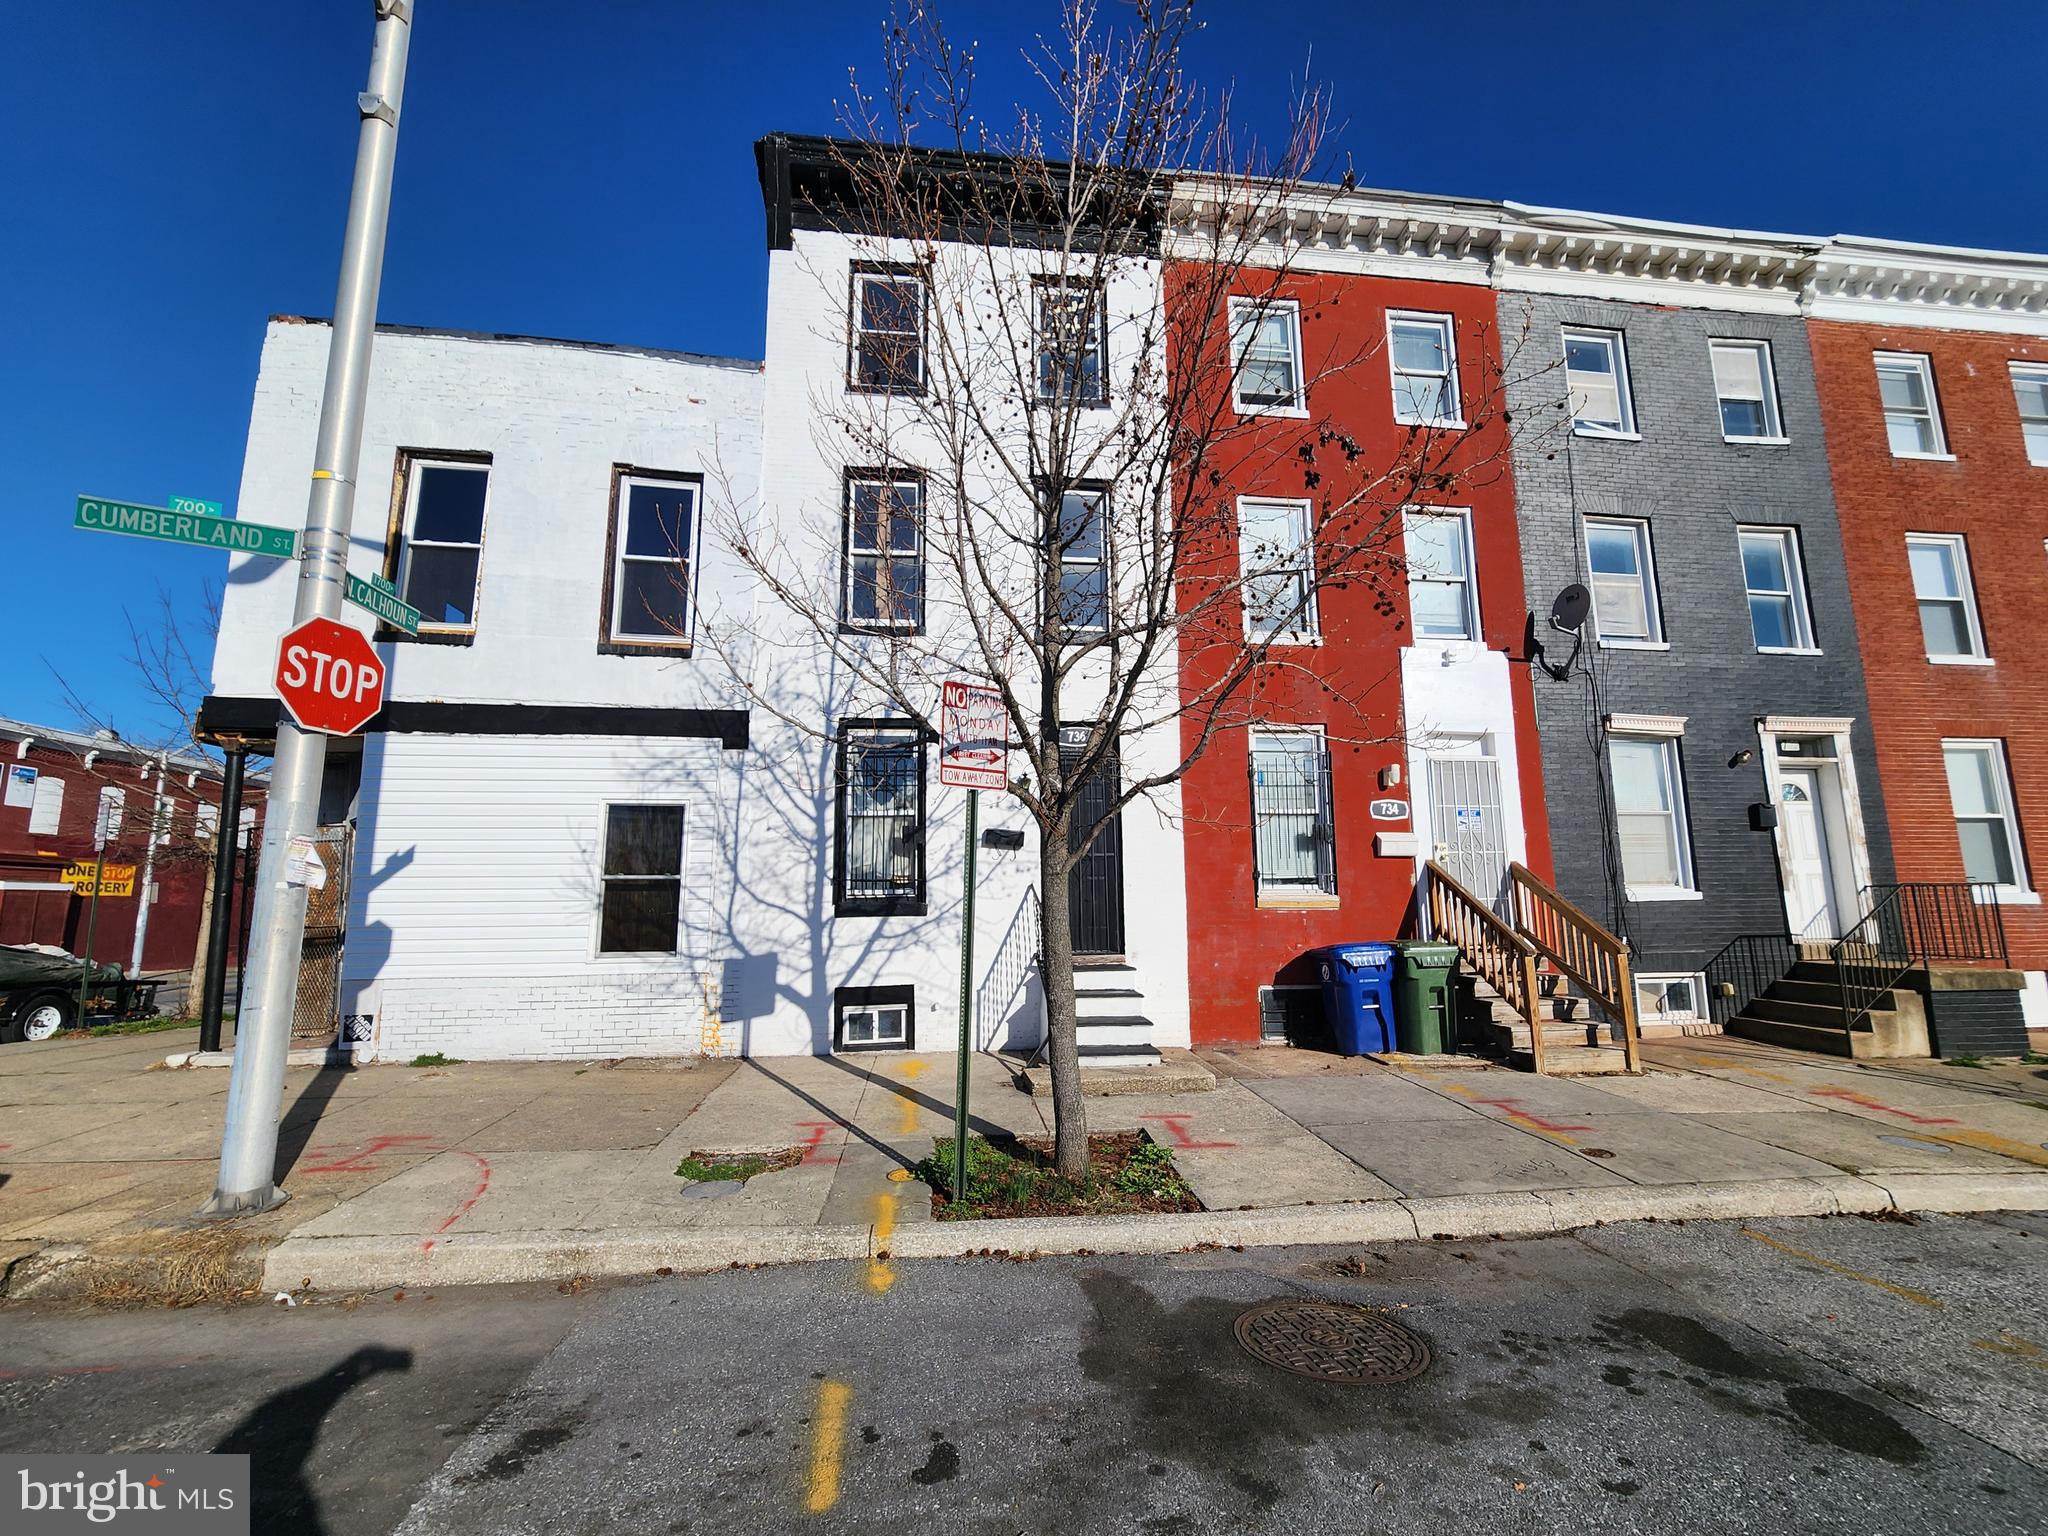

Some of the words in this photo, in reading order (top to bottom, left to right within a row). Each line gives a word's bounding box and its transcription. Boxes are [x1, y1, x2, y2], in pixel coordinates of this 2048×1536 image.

[174, 498, 206, 515] 700
[81, 502, 263, 549] CUMBERLAND
[373, 574, 391, 591] 1700
[357, 583, 408, 625] CALHOUN
[283, 645, 379, 703] STOP
[946, 685, 966, 707] NO
[969, 691, 1004, 710] PARKING
[949, 714, 1001, 731] MONDAY
[1067, 730, 1086, 743] 736
[944, 769, 961, 780] TOW
[963, 771, 983, 783] AWAY
[985, 774, 1004, 786] ZONE
[1380, 803, 1399, 815] 734
[66, 865, 95, 877] ONE
[102, 866, 132, 879] STOP
[68, 881, 129, 893] ROERY
